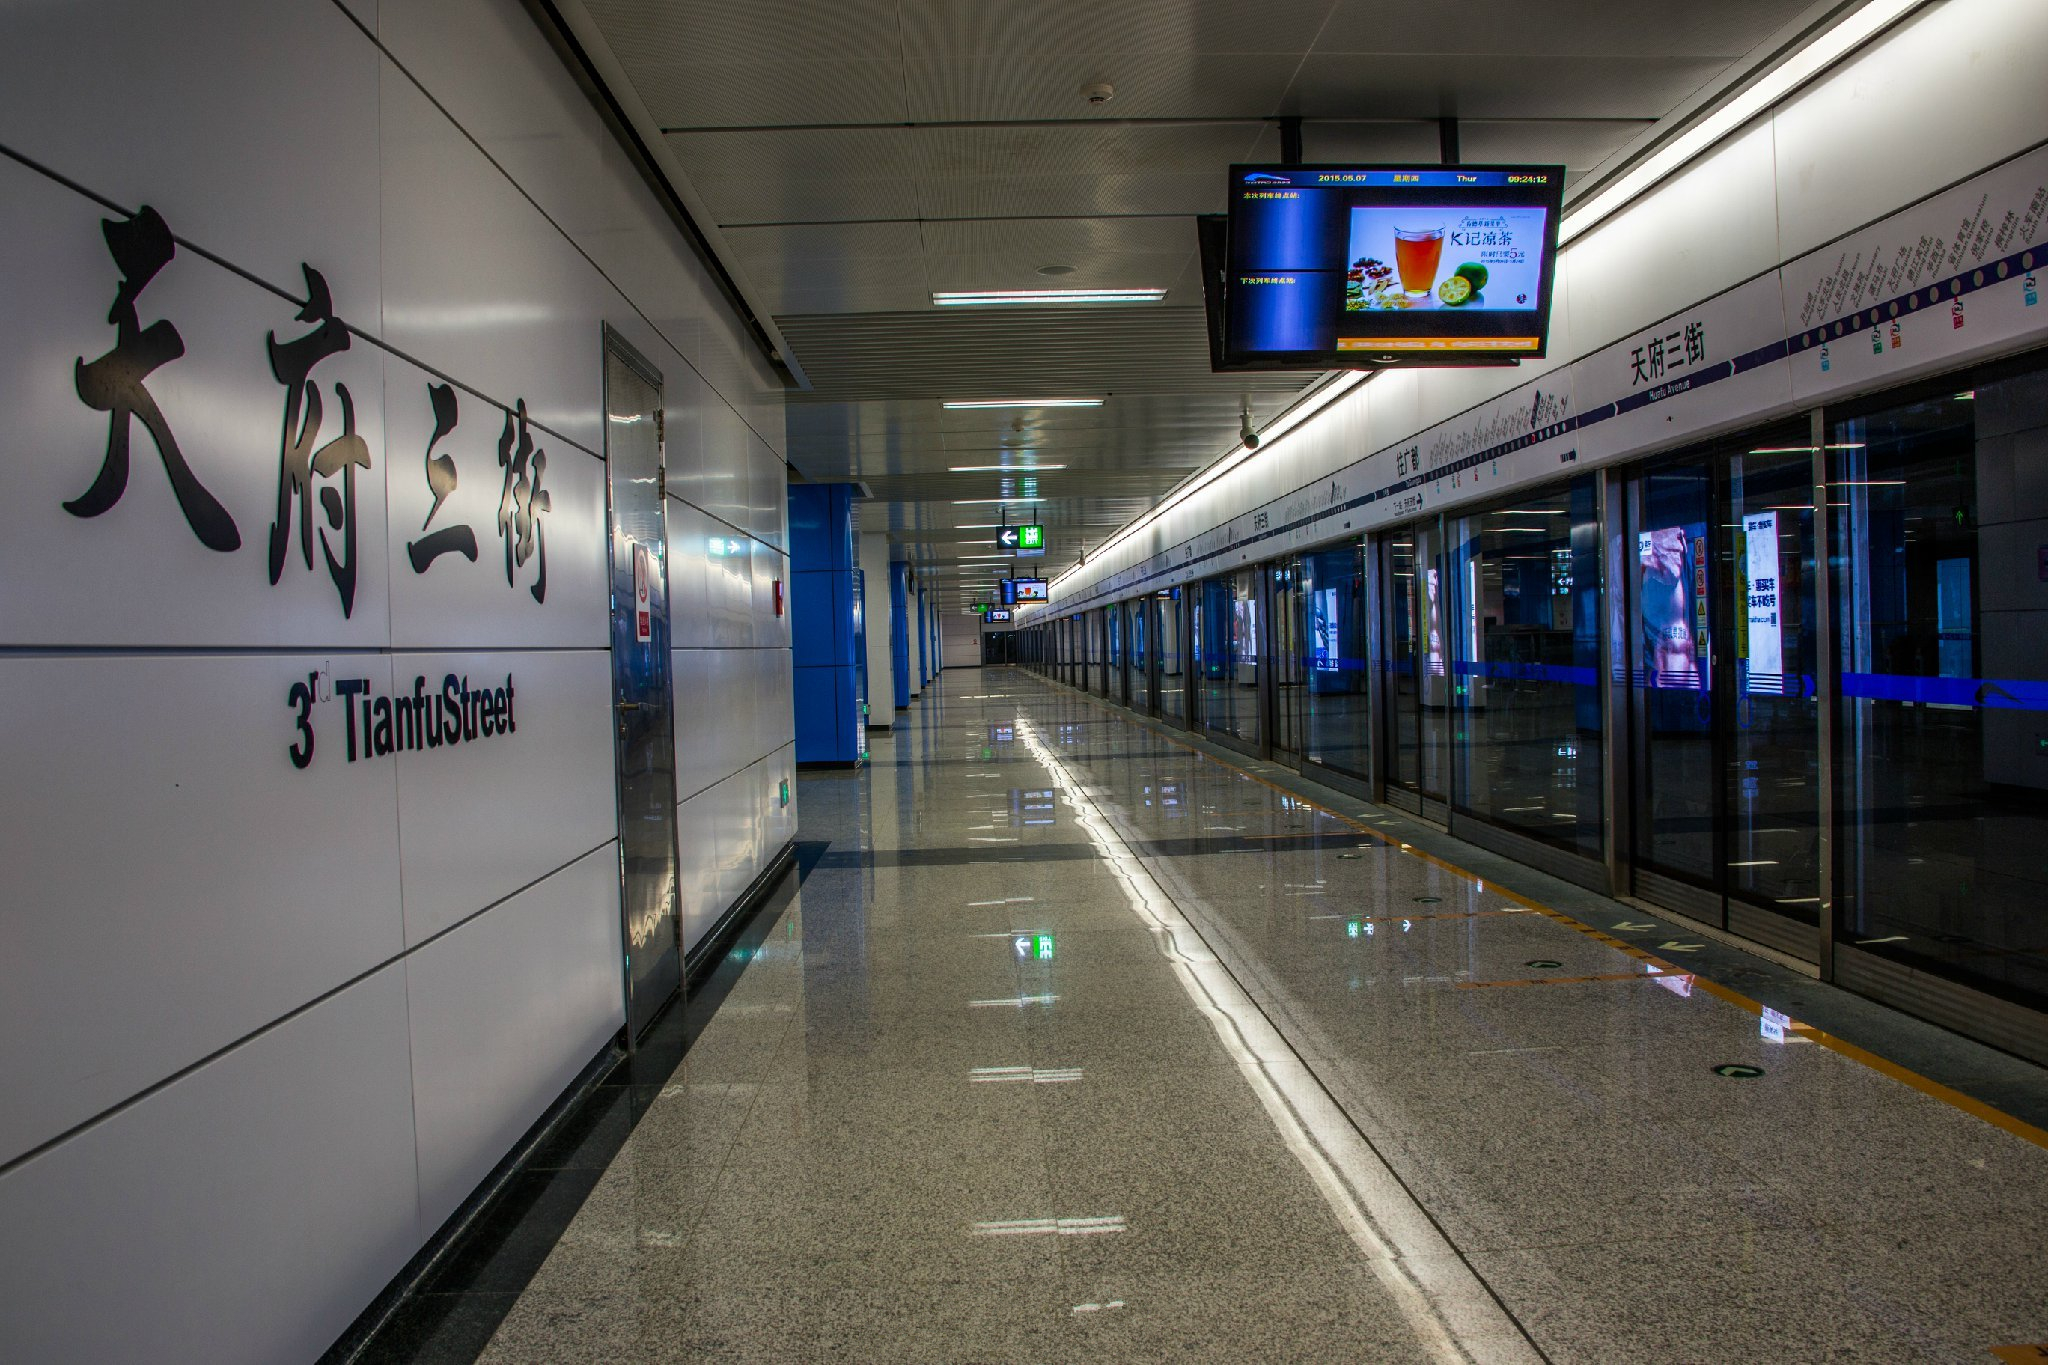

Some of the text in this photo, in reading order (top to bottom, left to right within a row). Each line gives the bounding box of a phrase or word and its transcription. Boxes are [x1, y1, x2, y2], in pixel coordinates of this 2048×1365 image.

[1318, 174, 1367, 182] 2015.05.07
[1456, 175, 1477, 183] Thur
[1450, 231, 1514, 247] K记凉茶
[1631, 322, 1705, 386] 天府三街
[1667, 380, 1690, 395] Avenue
[62, 204, 552, 620] 天府三街
[335, 672, 516, 763] TianfuStreet
